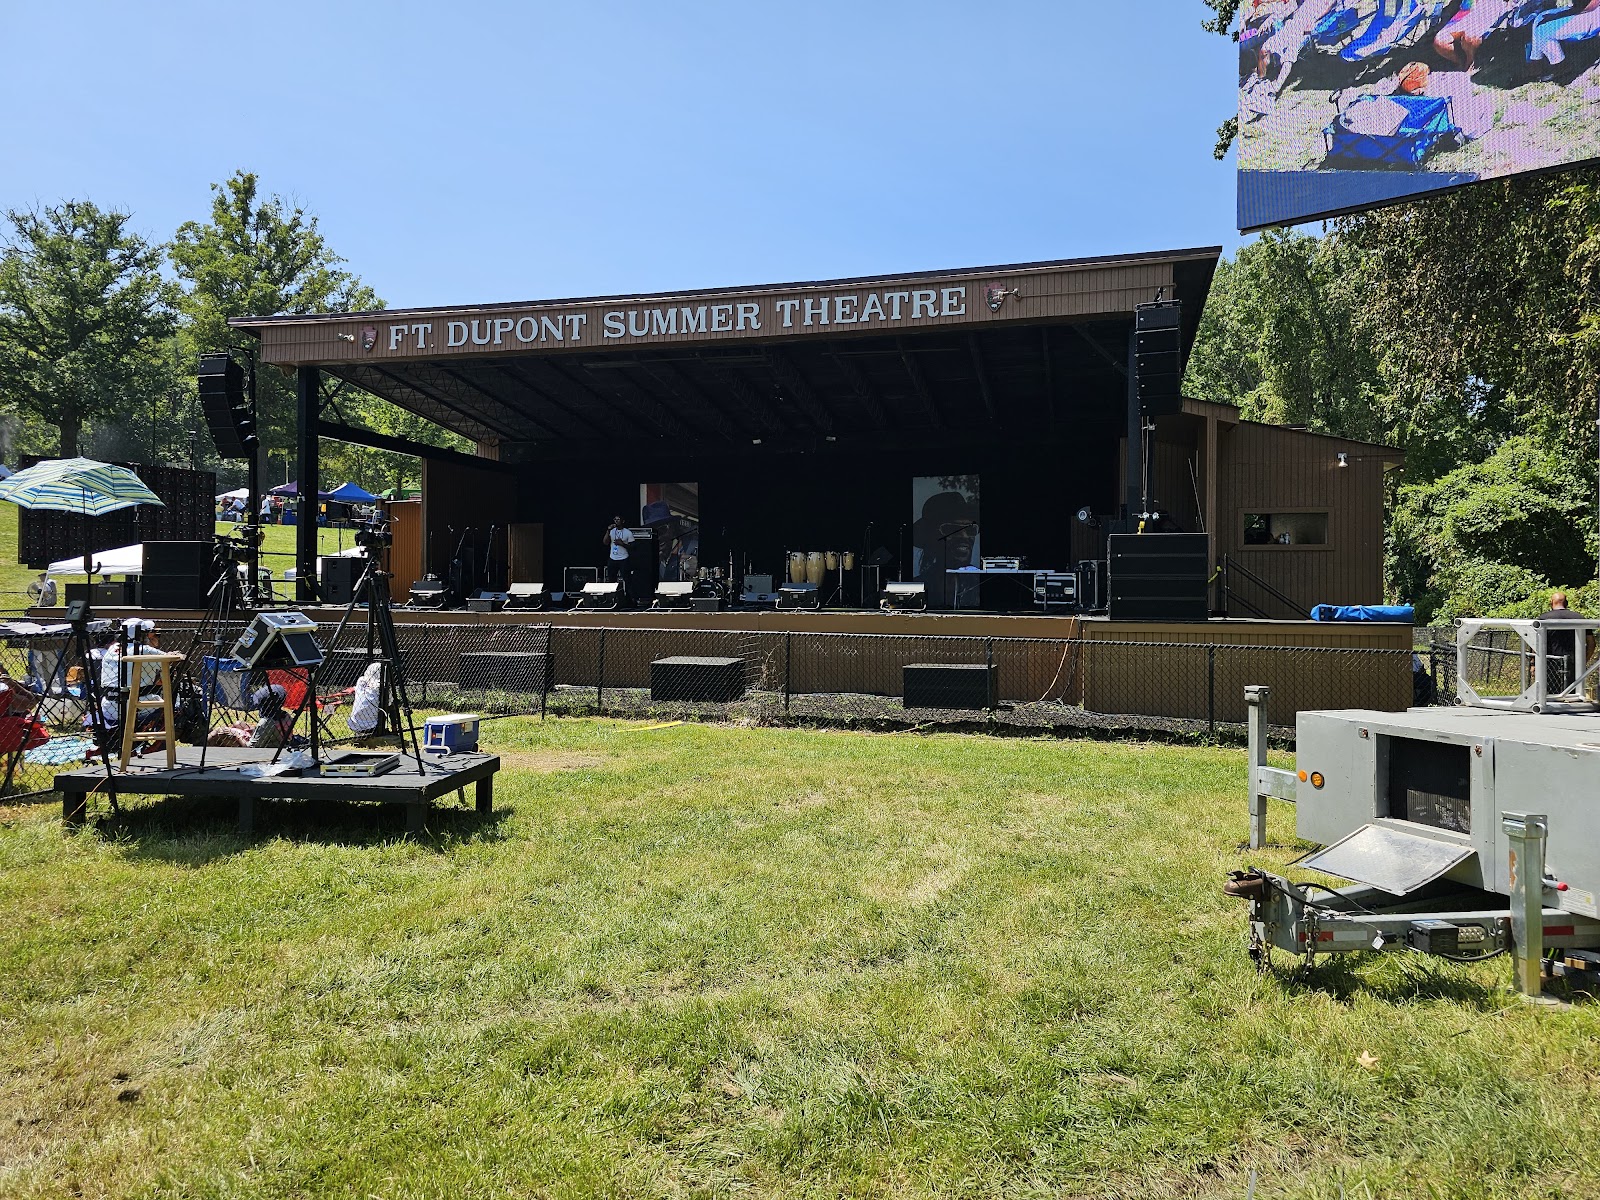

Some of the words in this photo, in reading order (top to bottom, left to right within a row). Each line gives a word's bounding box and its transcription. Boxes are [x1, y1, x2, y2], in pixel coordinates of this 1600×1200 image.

[389, 323, 435, 350] FT.
[447, 313, 587, 347] DUPONT
[603, 302, 762, 338] SUMMER
[776, 286, 966, 327] THEATRE
